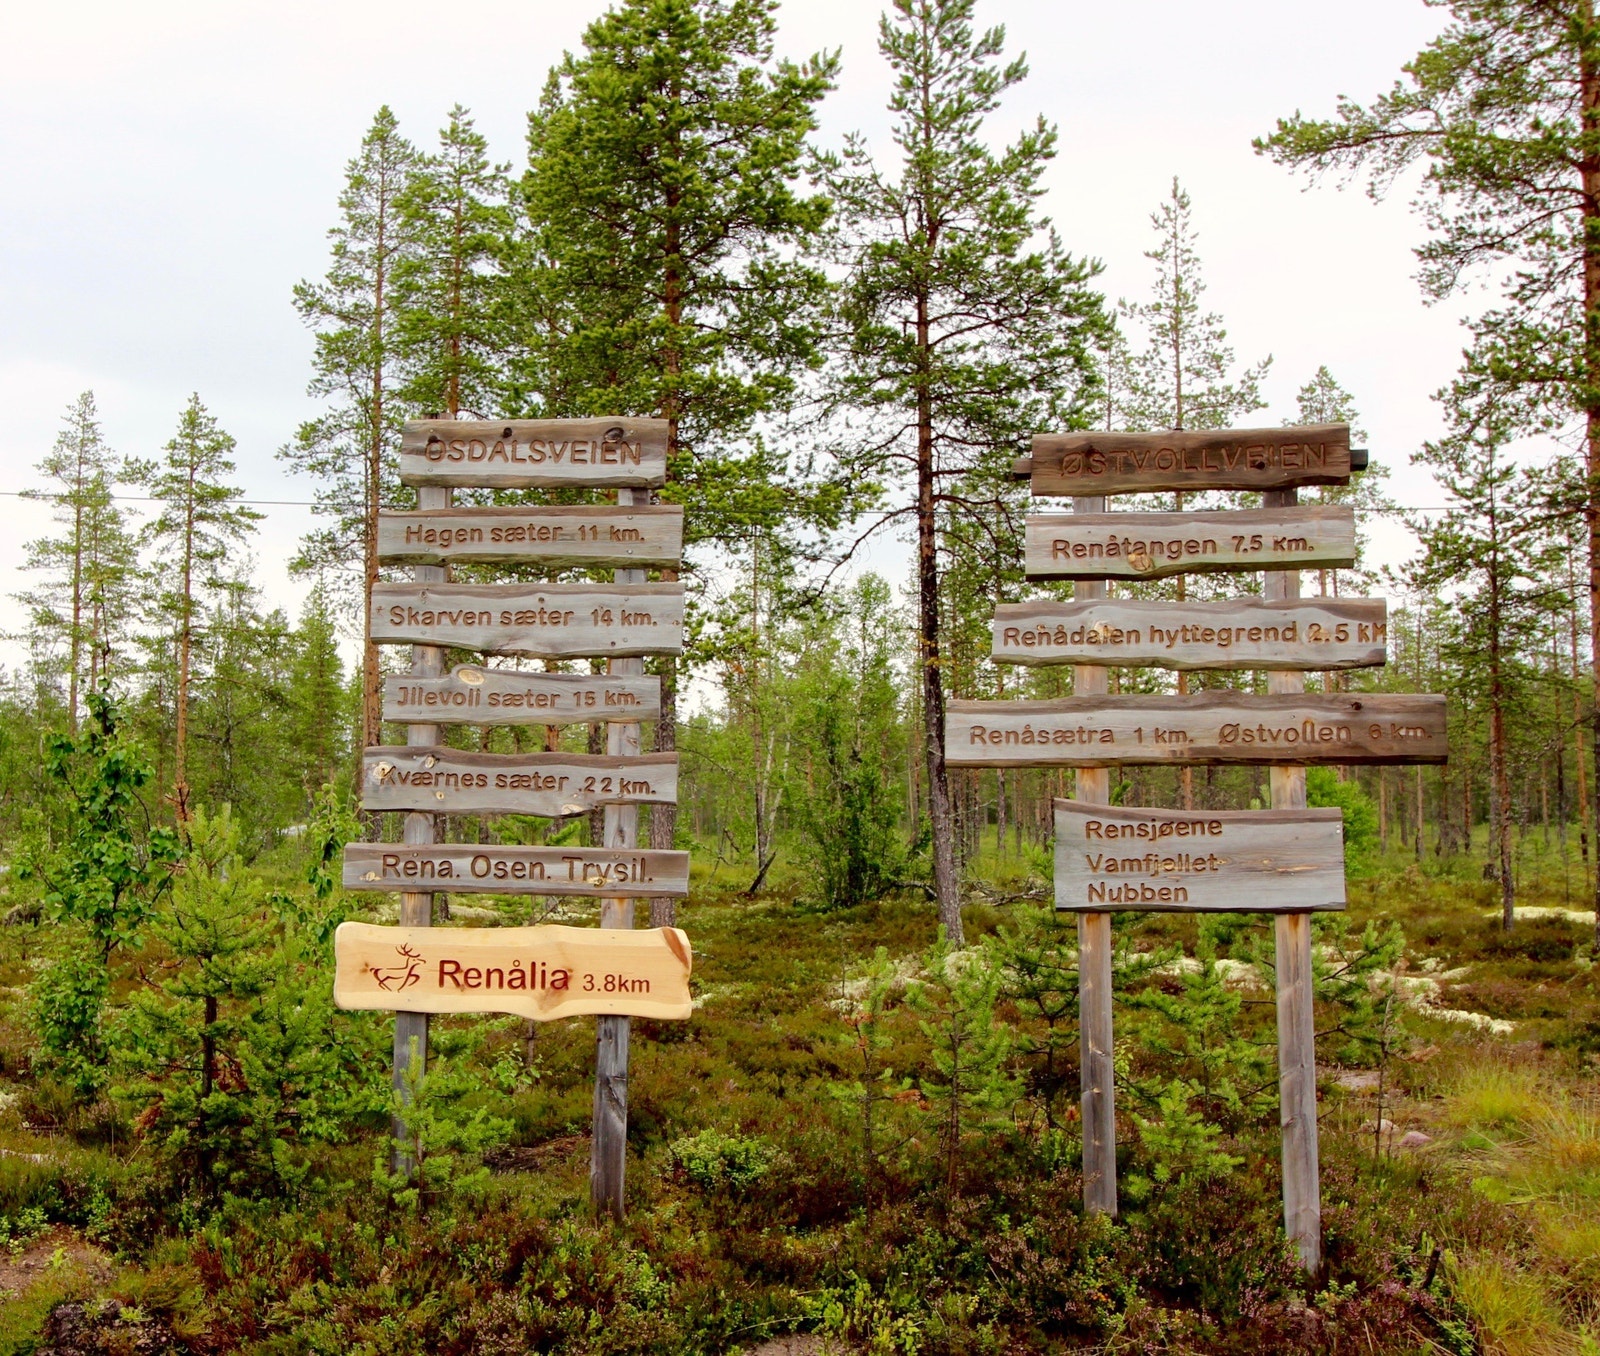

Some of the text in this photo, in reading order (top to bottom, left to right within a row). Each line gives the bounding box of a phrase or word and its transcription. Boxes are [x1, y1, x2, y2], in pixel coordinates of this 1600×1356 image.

[424, 439, 642, 466] OSDALSVEIEN
[1060, 441, 1327, 477] ØSTVOLLVEIEN
[405, 523, 645, 548] Hagen sæter 11 km.
[1052, 534, 1218, 560] Renåtangen
[1231, 534, 1264, 554] 7.5
[389, 605, 658, 627] Skarven sæter 14 km.
[1003, 622, 1141, 648] Renådalen
[1149, 620, 1297, 649] hyttegrend
[1307, 622, 1350, 643] 2.5
[488, 687, 561, 709] sæter
[573, 690, 596, 707] 15
[604, 689, 642, 707] km.
[970, 723, 1195, 746] Renåsætra 1 km.
[1218, 718, 1433, 744] Østvollen 6 km.
[379, 766, 488, 790] Kværnes
[495, 770, 570, 792] sæter
[620, 776, 657, 795] km.
[1085, 818, 1223, 842] Rensjøene
[381, 854, 654, 888] Rena. Osen. Trysil.
[1087, 881, 1189, 903] Nubben
[438, 958, 651, 994] Renålia 3.8km
